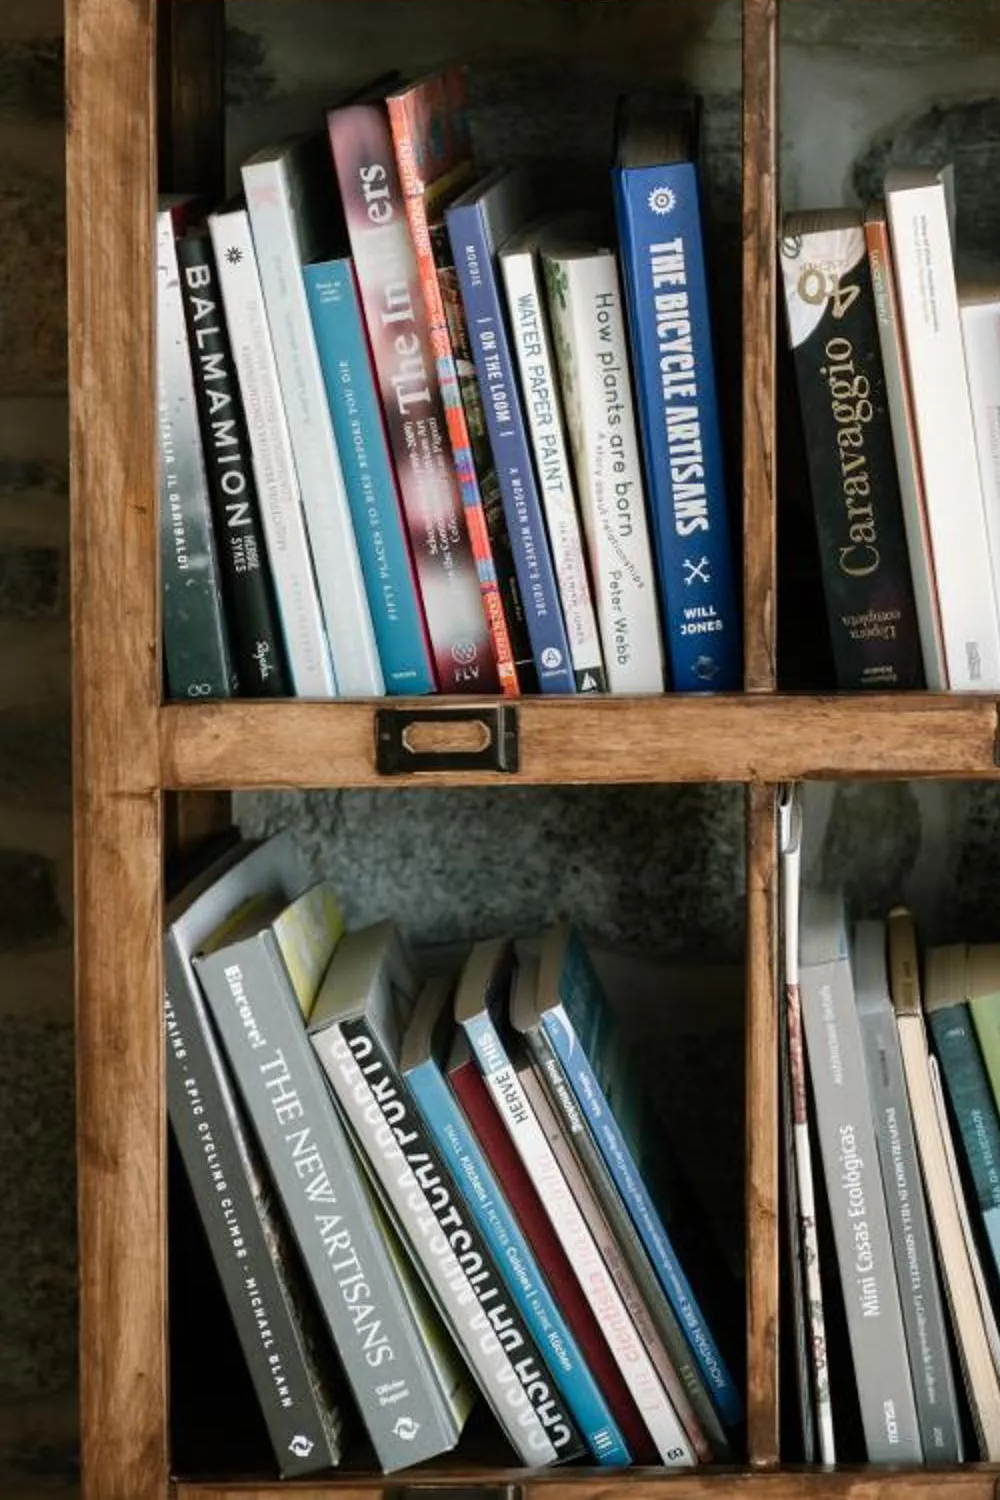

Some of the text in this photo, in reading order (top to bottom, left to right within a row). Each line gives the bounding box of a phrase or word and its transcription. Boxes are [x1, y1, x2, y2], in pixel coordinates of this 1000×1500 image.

[185, 265, 250, 525] BALMAMION
[390, 334, 430, 414] The
[479, 330, 510, 421] ON THE LOOM
[517, 293, 564, 492] WATER PAPER PAINT
[595, 292, 633, 537] How plants are born
[649, 237, 708, 534] THE BICYCLE ARTISANS
[825, 338, 879, 575] Caravaggio
[608, 569, 630, 665] Peter Webb
[680, 619, 722, 635] JONES
[683, 605, 716, 619] WILL
[184, 1078, 226, 1191] EPIC CYCLING
[259, 1049, 393, 1366] THE NEW ARTISANS
[838, 1124, 879, 1316] Mini Casas Ecológicas
[221, 1198, 292, 1407] CLIMBS MICHAEL BLANN
[465, 1299, 574, 1459] CASA DA
